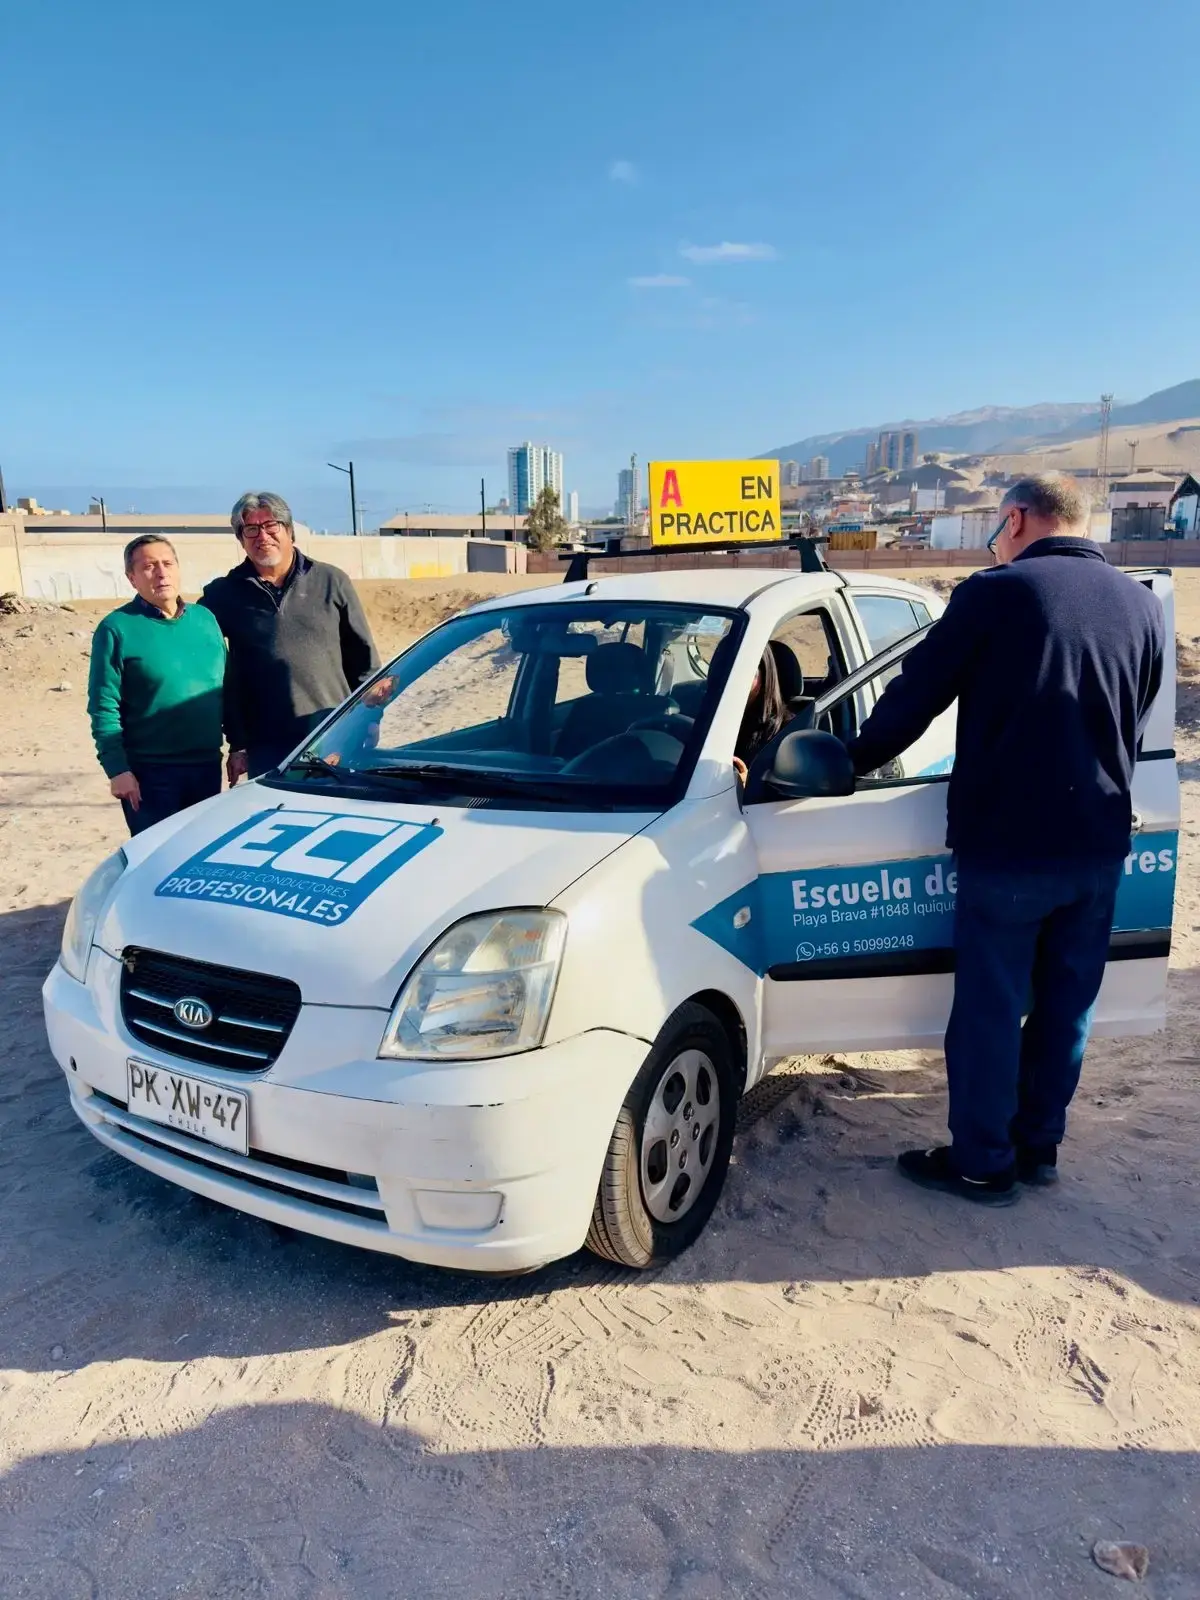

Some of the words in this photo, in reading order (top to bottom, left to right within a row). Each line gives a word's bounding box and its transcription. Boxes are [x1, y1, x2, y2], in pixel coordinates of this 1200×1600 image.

[660, 469, 683, 508] A
[741, 475, 772, 500] EN
[660, 509, 776, 537] PRACTICA
[203, 811, 425, 884] ECI
[235, 870, 256, 881] DE
[254, 873, 351, 899] CONDUCTORES
[791, 869, 912, 910] Escuela
[924, 863, 957, 897] de
[159, 877, 349, 922] PROFESIONALES
[793, 914, 828, 928] Playa
[831, 909, 867, 924] Brava
[870, 902, 910, 920] #1848
[816, 942, 839, 956] +56
[842, 941, 850, 954] 9
[853, 934, 914, 953] 50999248
[179, 1003, 205, 1023] KIA
[168, 1114, 207, 1136] CHILE
